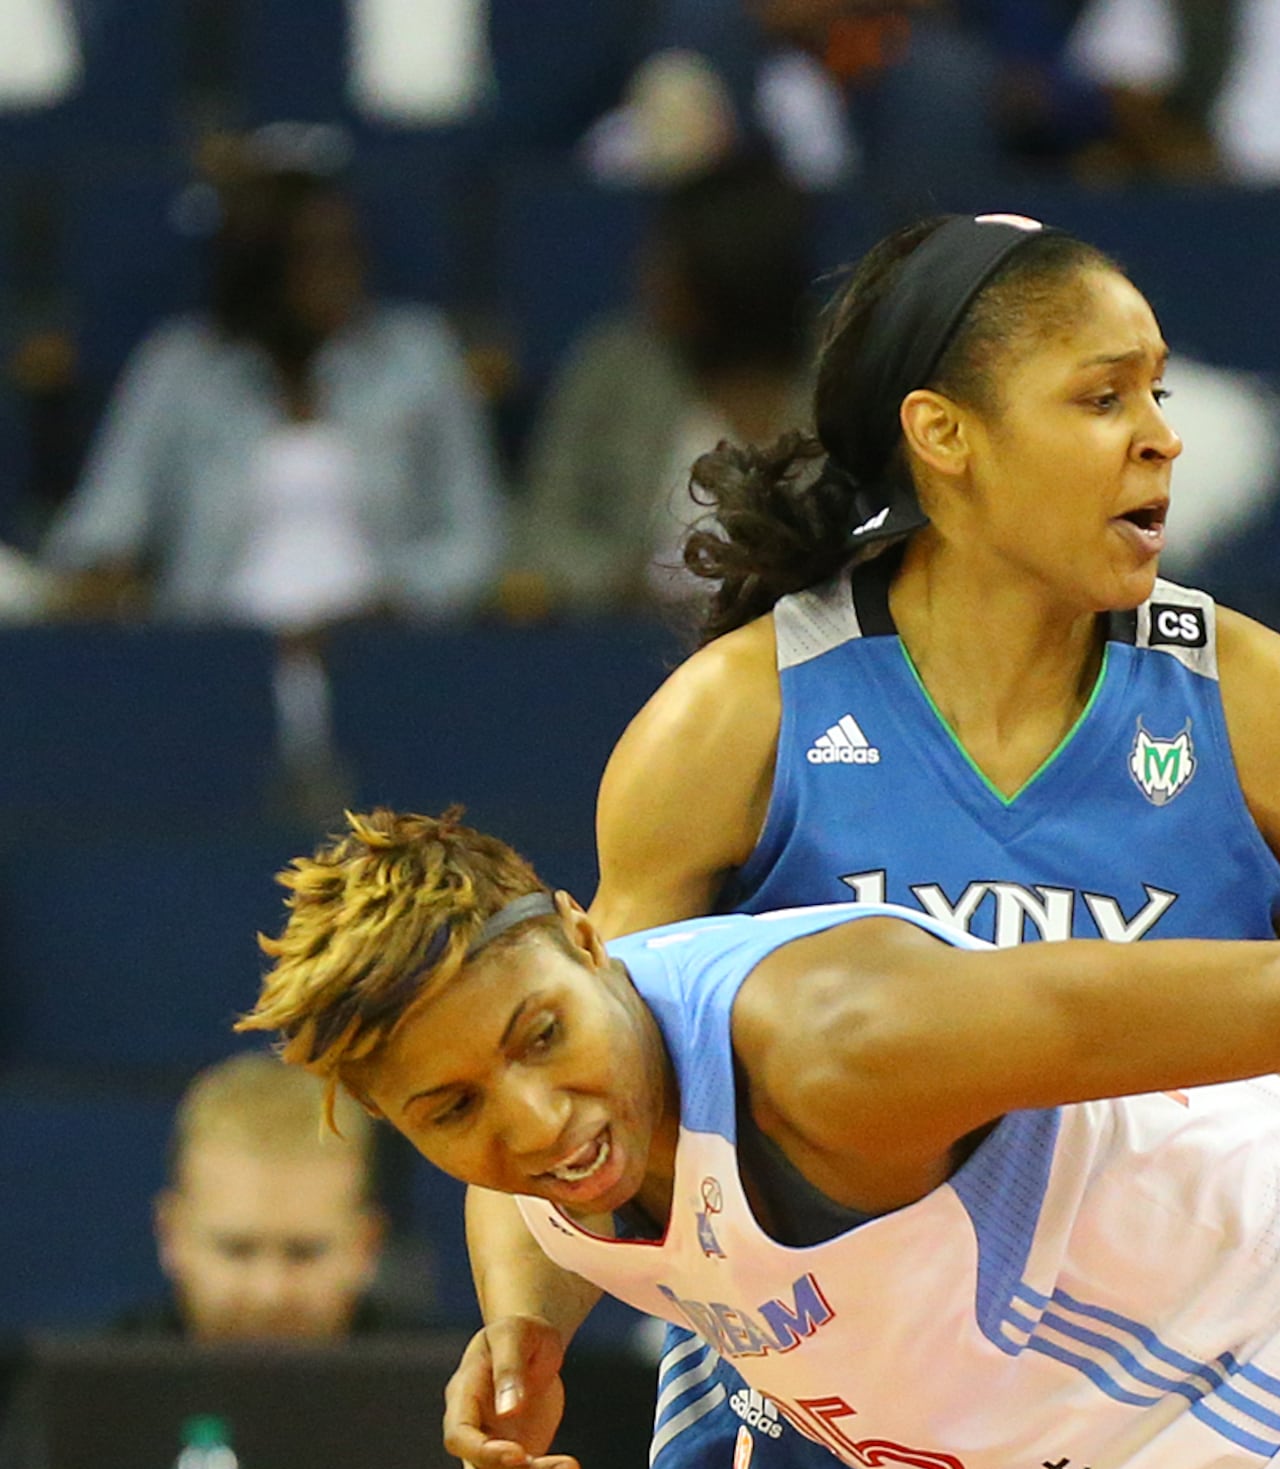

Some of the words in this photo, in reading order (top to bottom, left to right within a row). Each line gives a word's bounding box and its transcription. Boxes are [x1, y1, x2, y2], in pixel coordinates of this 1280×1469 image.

[1157, 609, 1200, 641] CS
[807, 743, 880, 765] adidas
[729, 1393, 783, 1439] adidas
